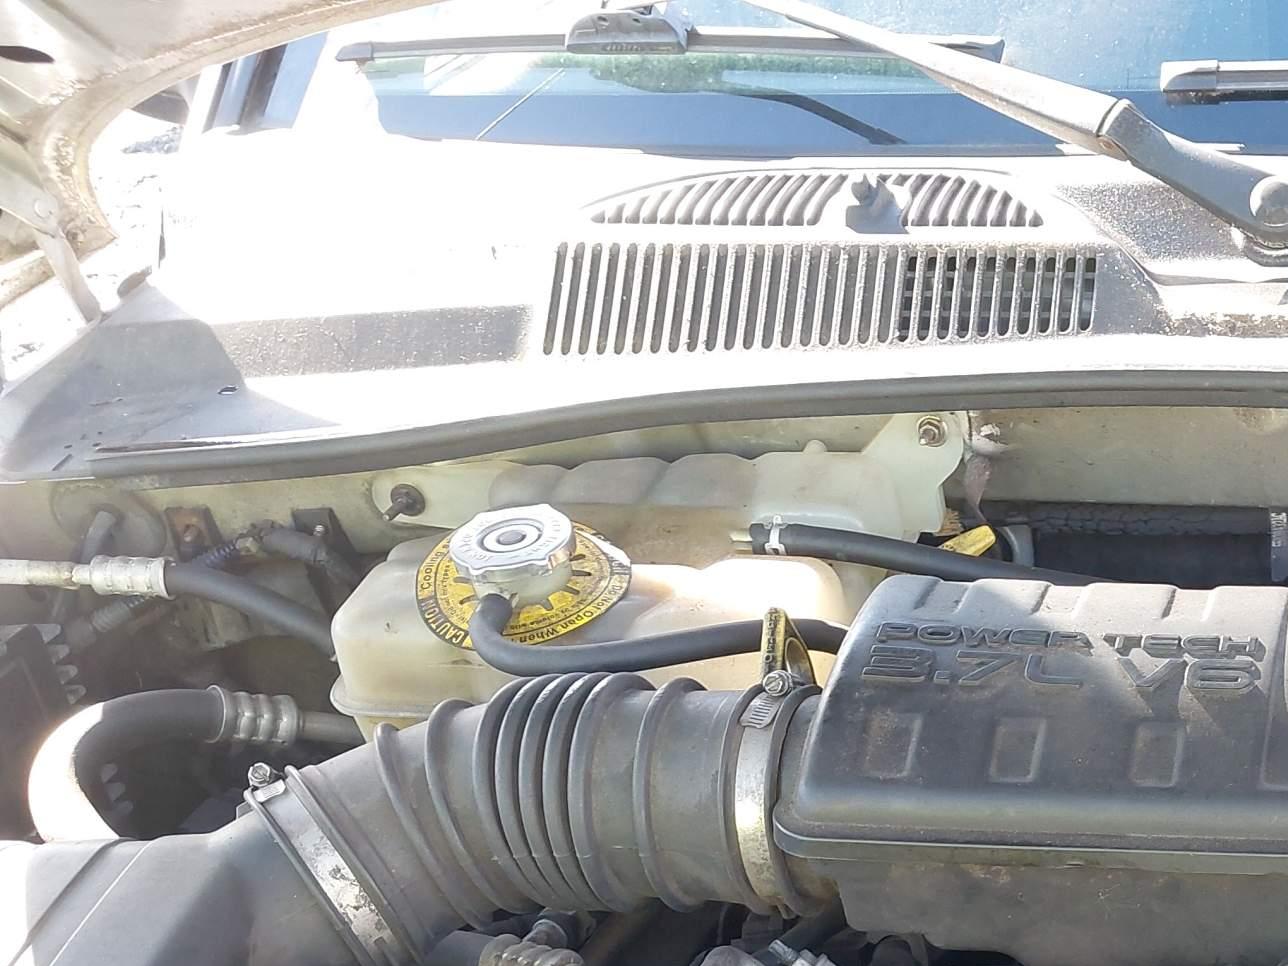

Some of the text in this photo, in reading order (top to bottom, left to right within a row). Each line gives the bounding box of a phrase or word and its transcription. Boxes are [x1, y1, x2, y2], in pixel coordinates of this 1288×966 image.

[421, 548, 444, 590] Cooling
[419, 598, 468, 646] CAUTION
[559, 610, 594, 630] Open
[593, 594, 611, 614] Not
[517, 626, 560, 644] When
[876, 622, 1267, 663] POWER TECH
[862, 644, 1261, 691] 3.7L V6
